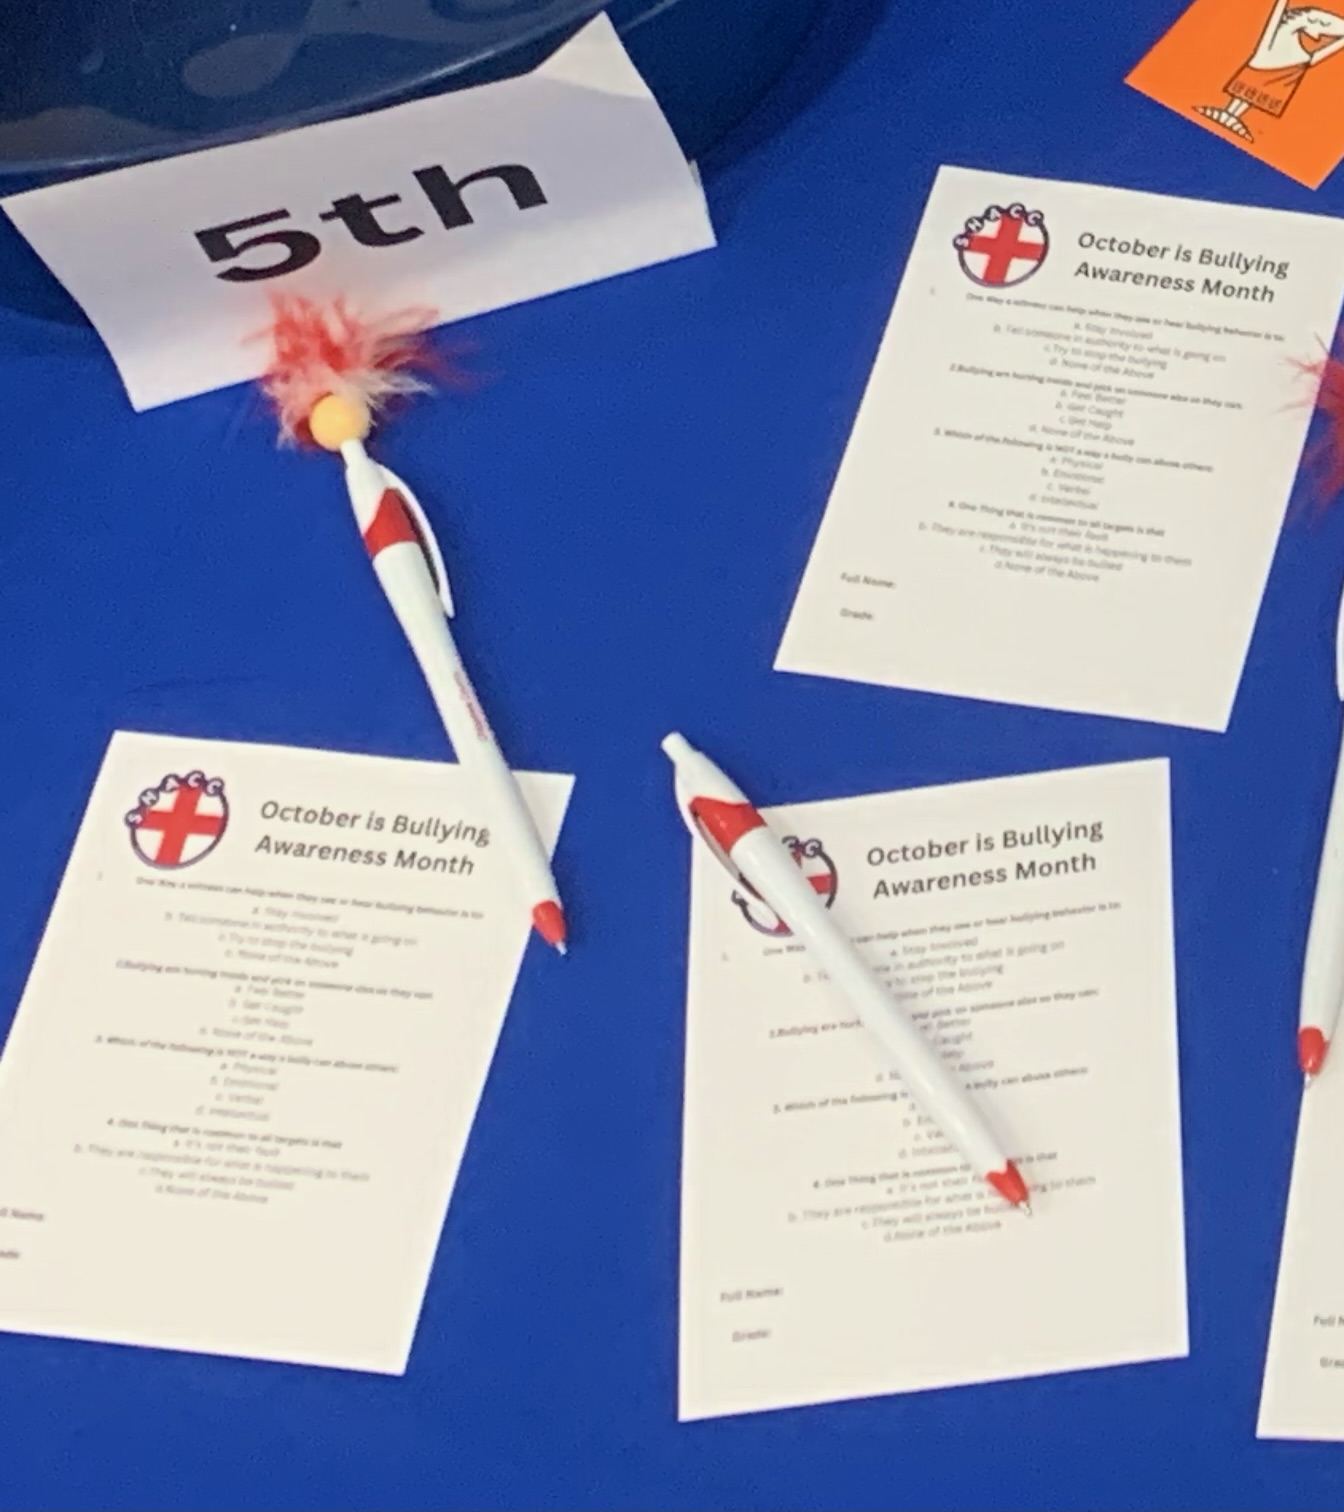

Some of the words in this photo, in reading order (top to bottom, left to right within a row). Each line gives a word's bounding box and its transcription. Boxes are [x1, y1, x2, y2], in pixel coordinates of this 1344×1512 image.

[194, 162, 549, 283] 5th
[1077, 231, 1193, 264] October
[1173, 243, 1193, 264] is
[1197, 247, 1290, 281] Bullying
[1073, 260, 1196, 293] Awareness
[1200, 277, 1275, 304] Month
[260, 799, 362, 829] October
[365, 810, 386, 833] is
[391, 813, 491, 849] Bullying
[866, 839, 970, 867] October
[975, 832, 996, 854] is
[1002, 820, 1105, 850] Bullying
[254, 834, 388, 867] Awareness
[393, 848, 475, 876] Month
[872, 867, 1008, 900] Awareness
[1014, 852, 1097, 881] Month
